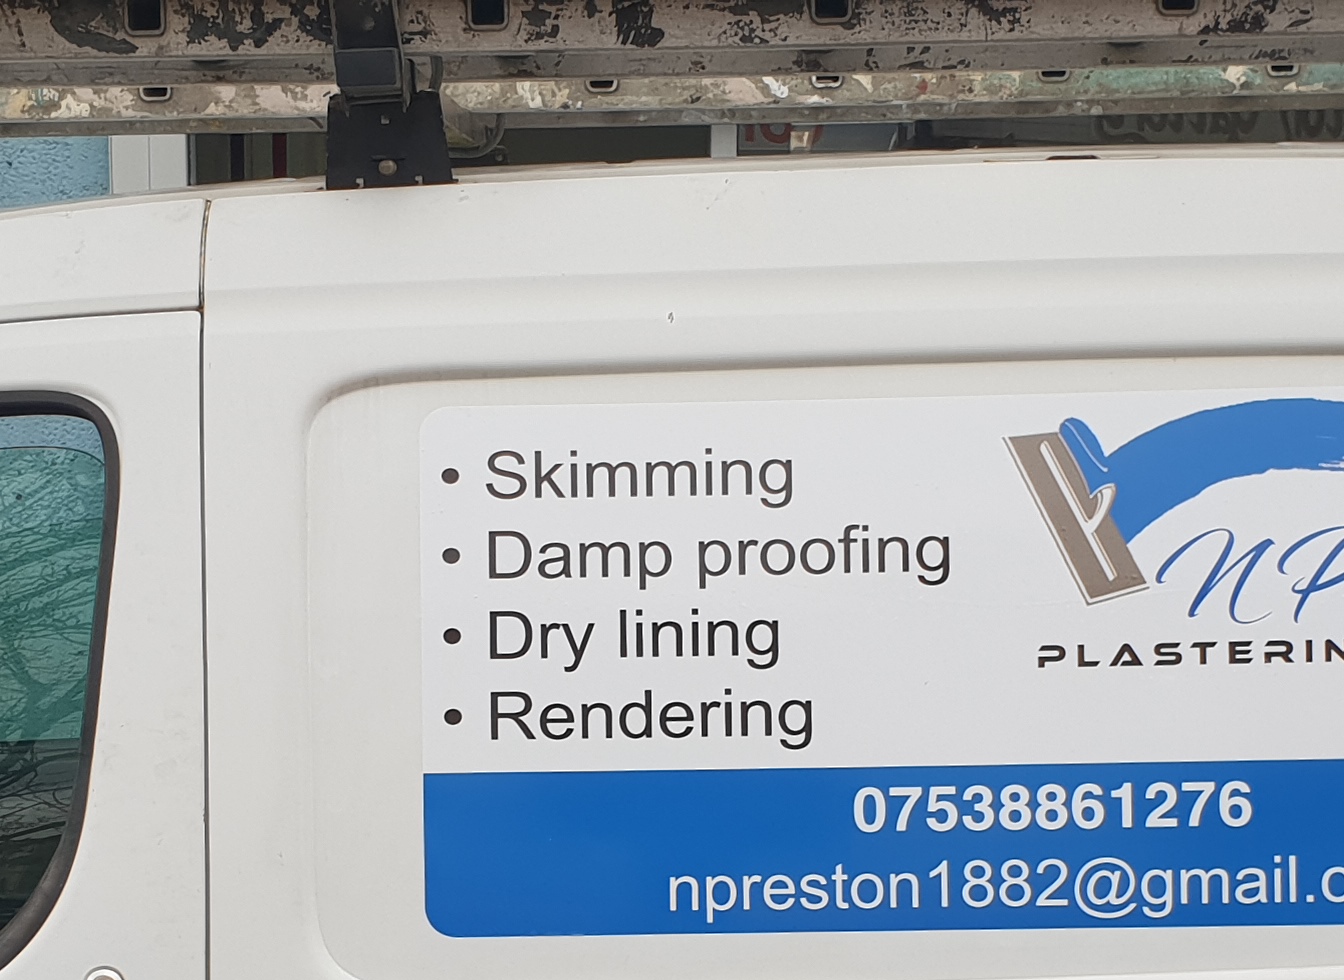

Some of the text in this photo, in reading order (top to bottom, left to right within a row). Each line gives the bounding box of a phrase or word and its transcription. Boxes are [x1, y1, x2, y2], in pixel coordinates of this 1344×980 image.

[486, 447, 793, 508] Skimming
[488, 524, 951, 590] Damp proofing
[1155, 528, 1275, 624] N
[489, 608, 780, 672] Dry lining
[490, 688, 813, 750] Rendering
[853, 780, 1253, 833] 07538861276
